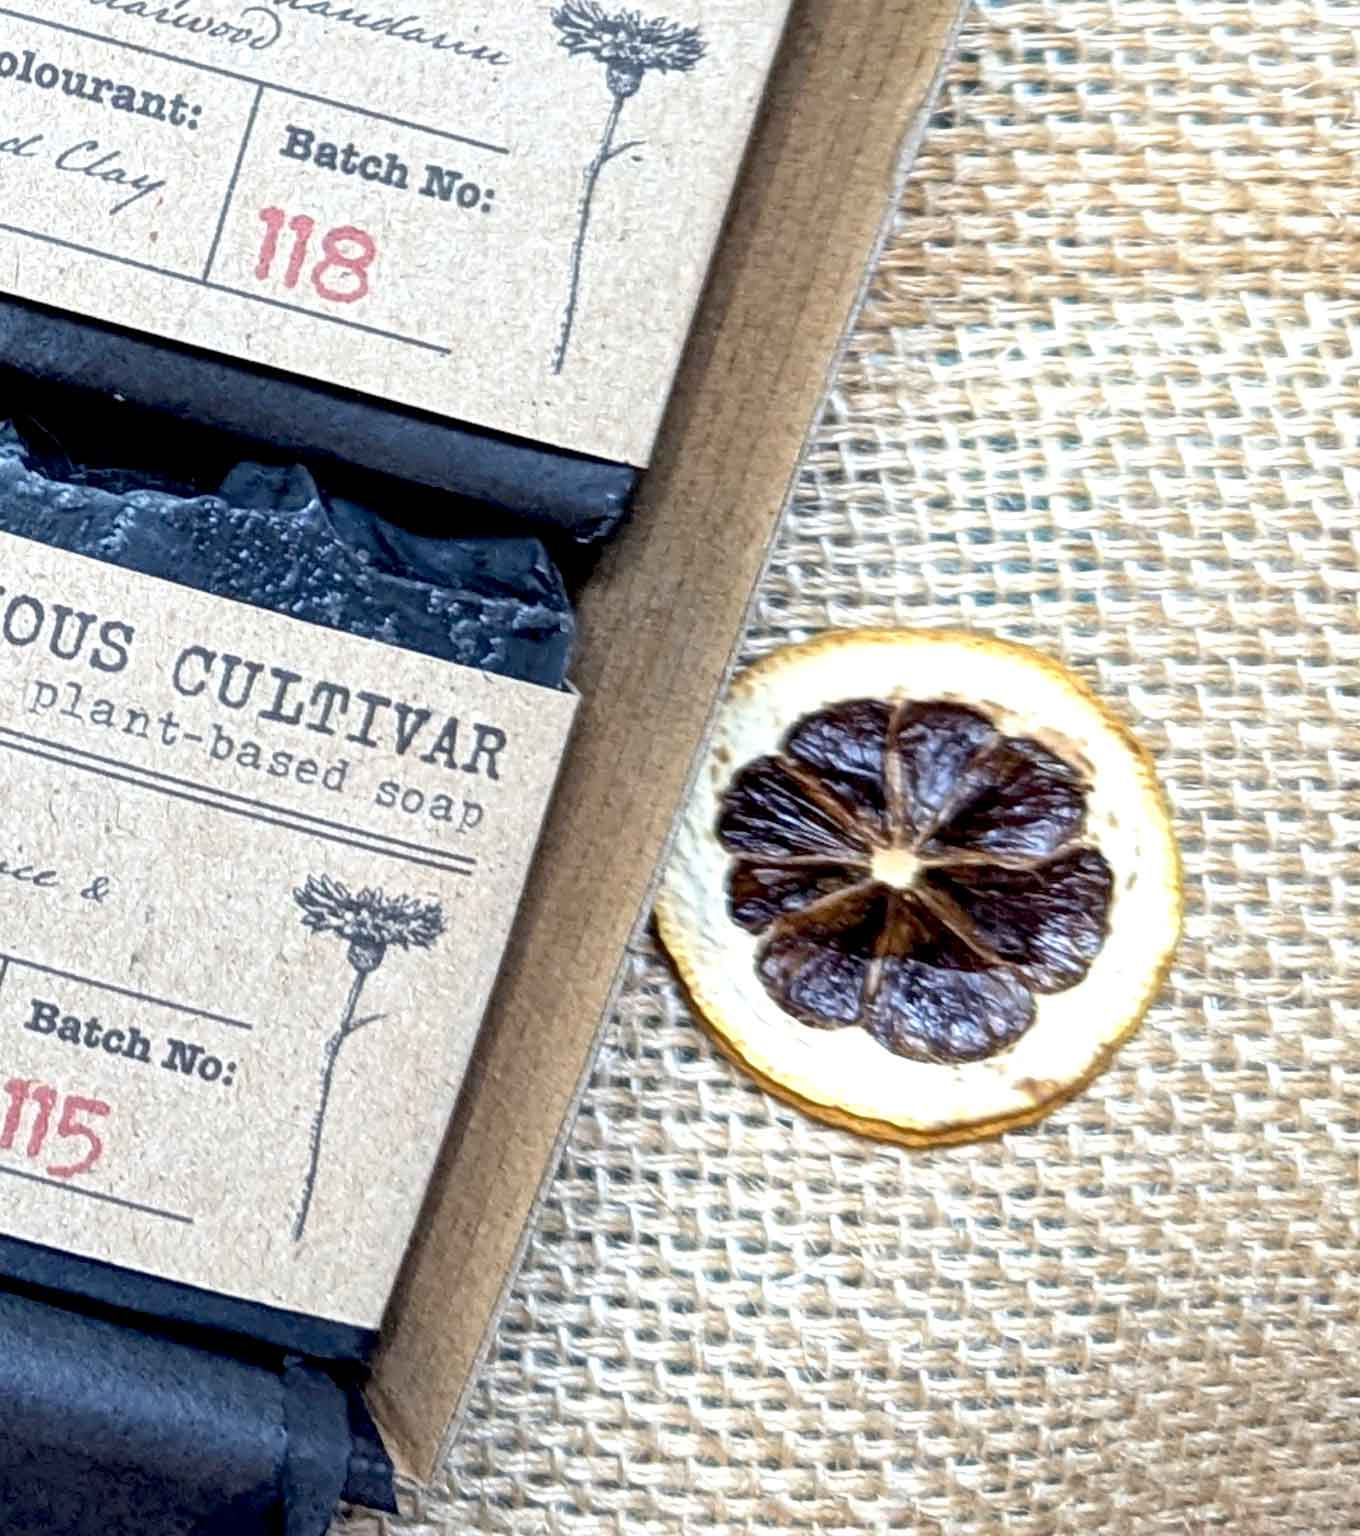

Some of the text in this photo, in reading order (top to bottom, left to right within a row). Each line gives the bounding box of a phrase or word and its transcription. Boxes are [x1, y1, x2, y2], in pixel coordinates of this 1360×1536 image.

[54, 139, 166, 216] Clay
[278, 123, 495, 214] Batch No:
[254, 205, 377, 304] 118
[27, 679, 350, 793] plant-based
[373, 779, 484, 833] soap
[171, 643, 508, 782] CULTIVAR
[79, 875, 110, 903] &
[22, 997, 237, 1087] Batch No:
